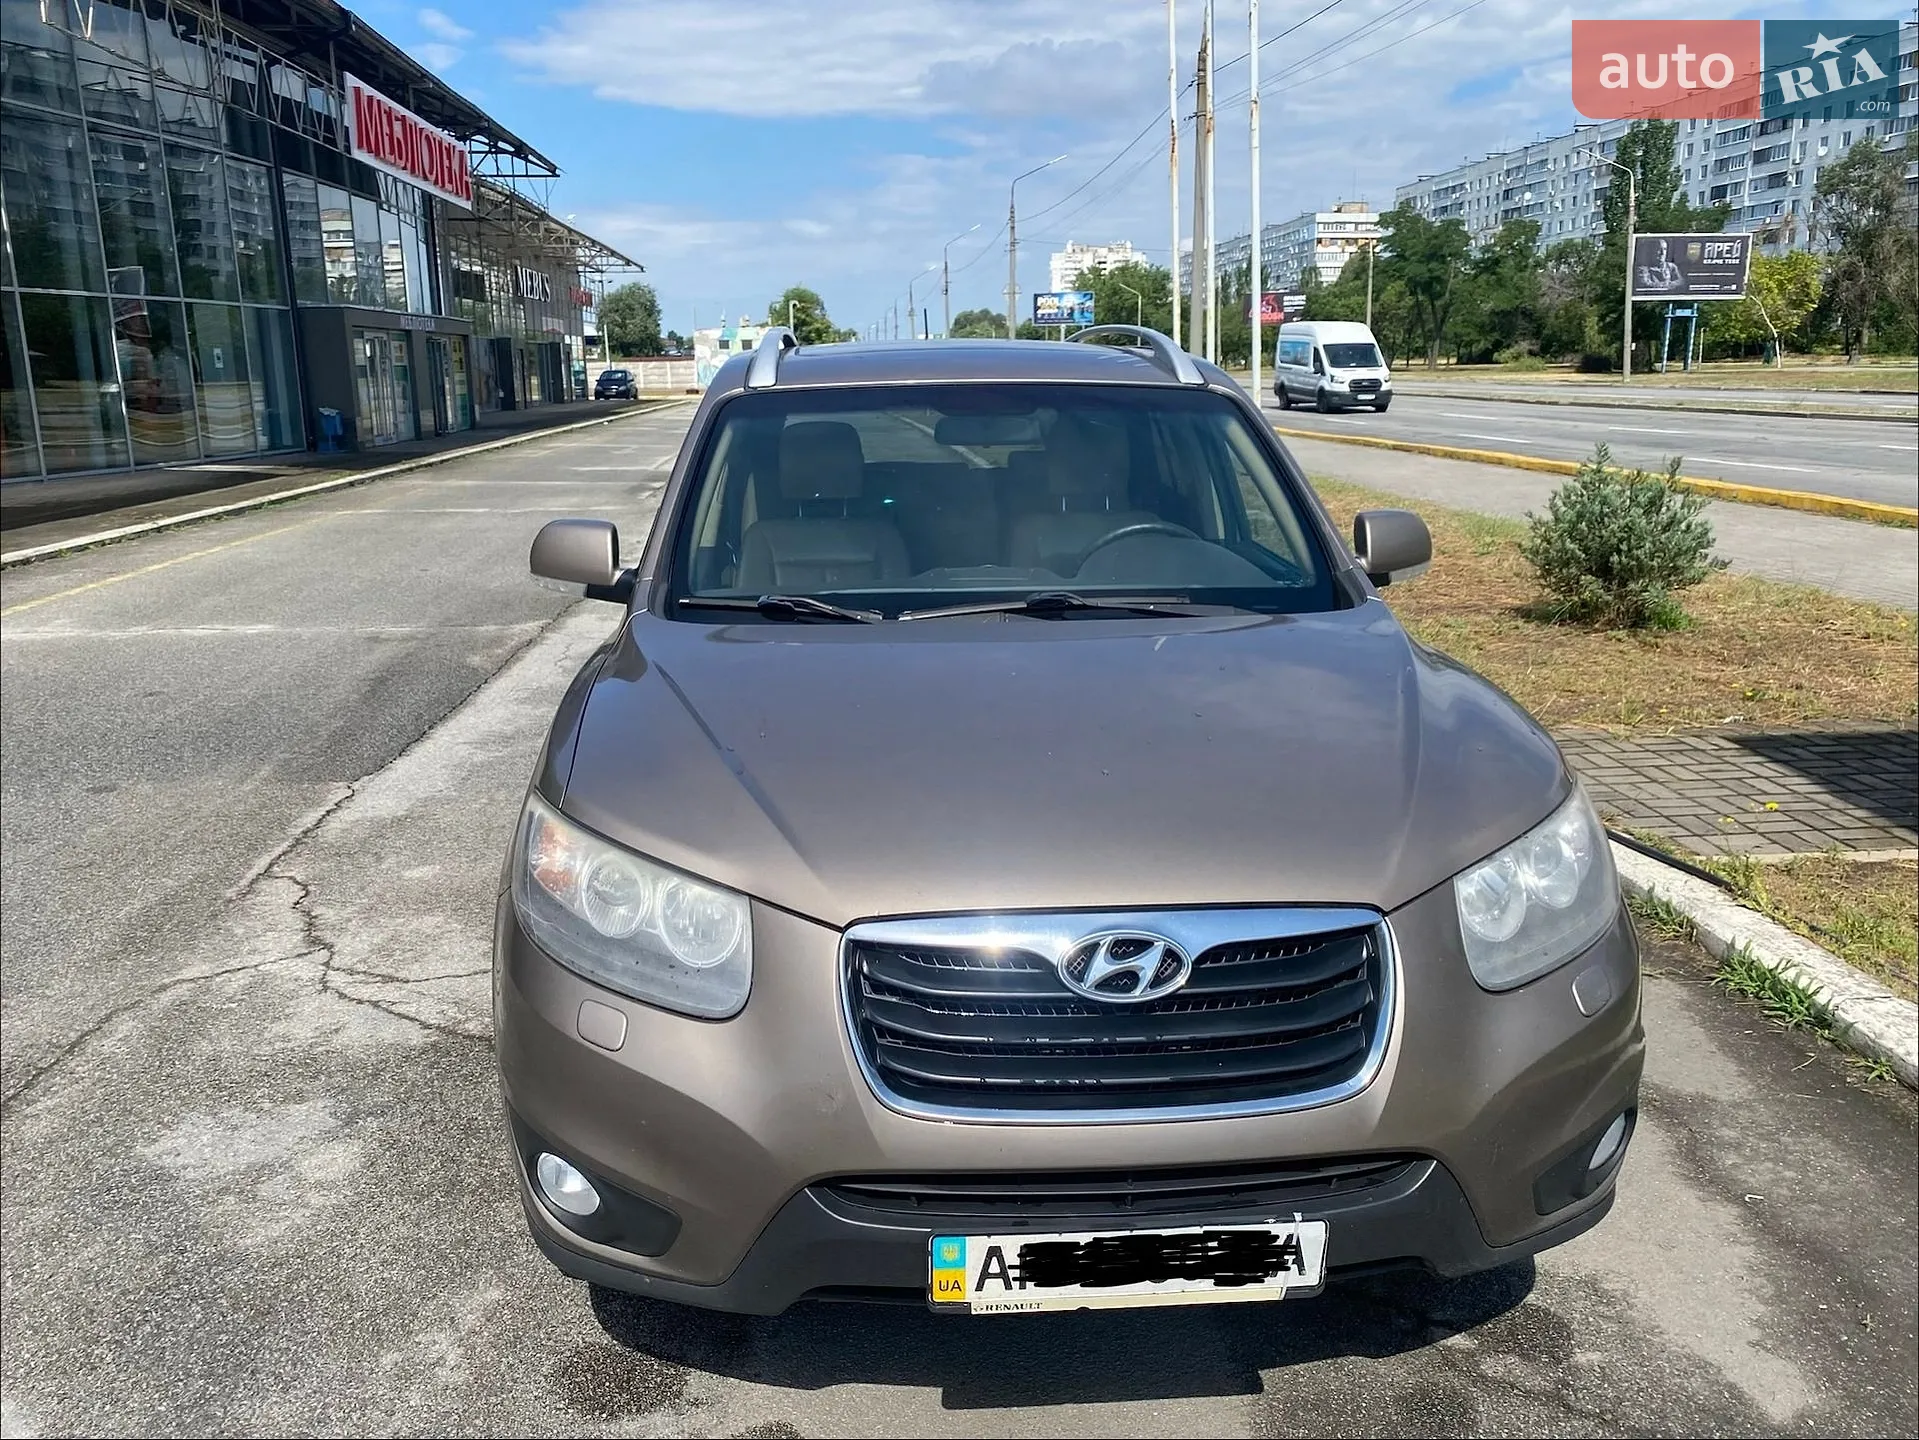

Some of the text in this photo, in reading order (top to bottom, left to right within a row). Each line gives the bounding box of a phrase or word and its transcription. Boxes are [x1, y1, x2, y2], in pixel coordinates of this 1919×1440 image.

[352, 86, 472, 201] МЕБЛІОТЕКА
[516, 265, 551, 303] MEBUS
[938, 1279, 963, 1292] UA
[985, 1302, 1043, 1312] RENAULT
